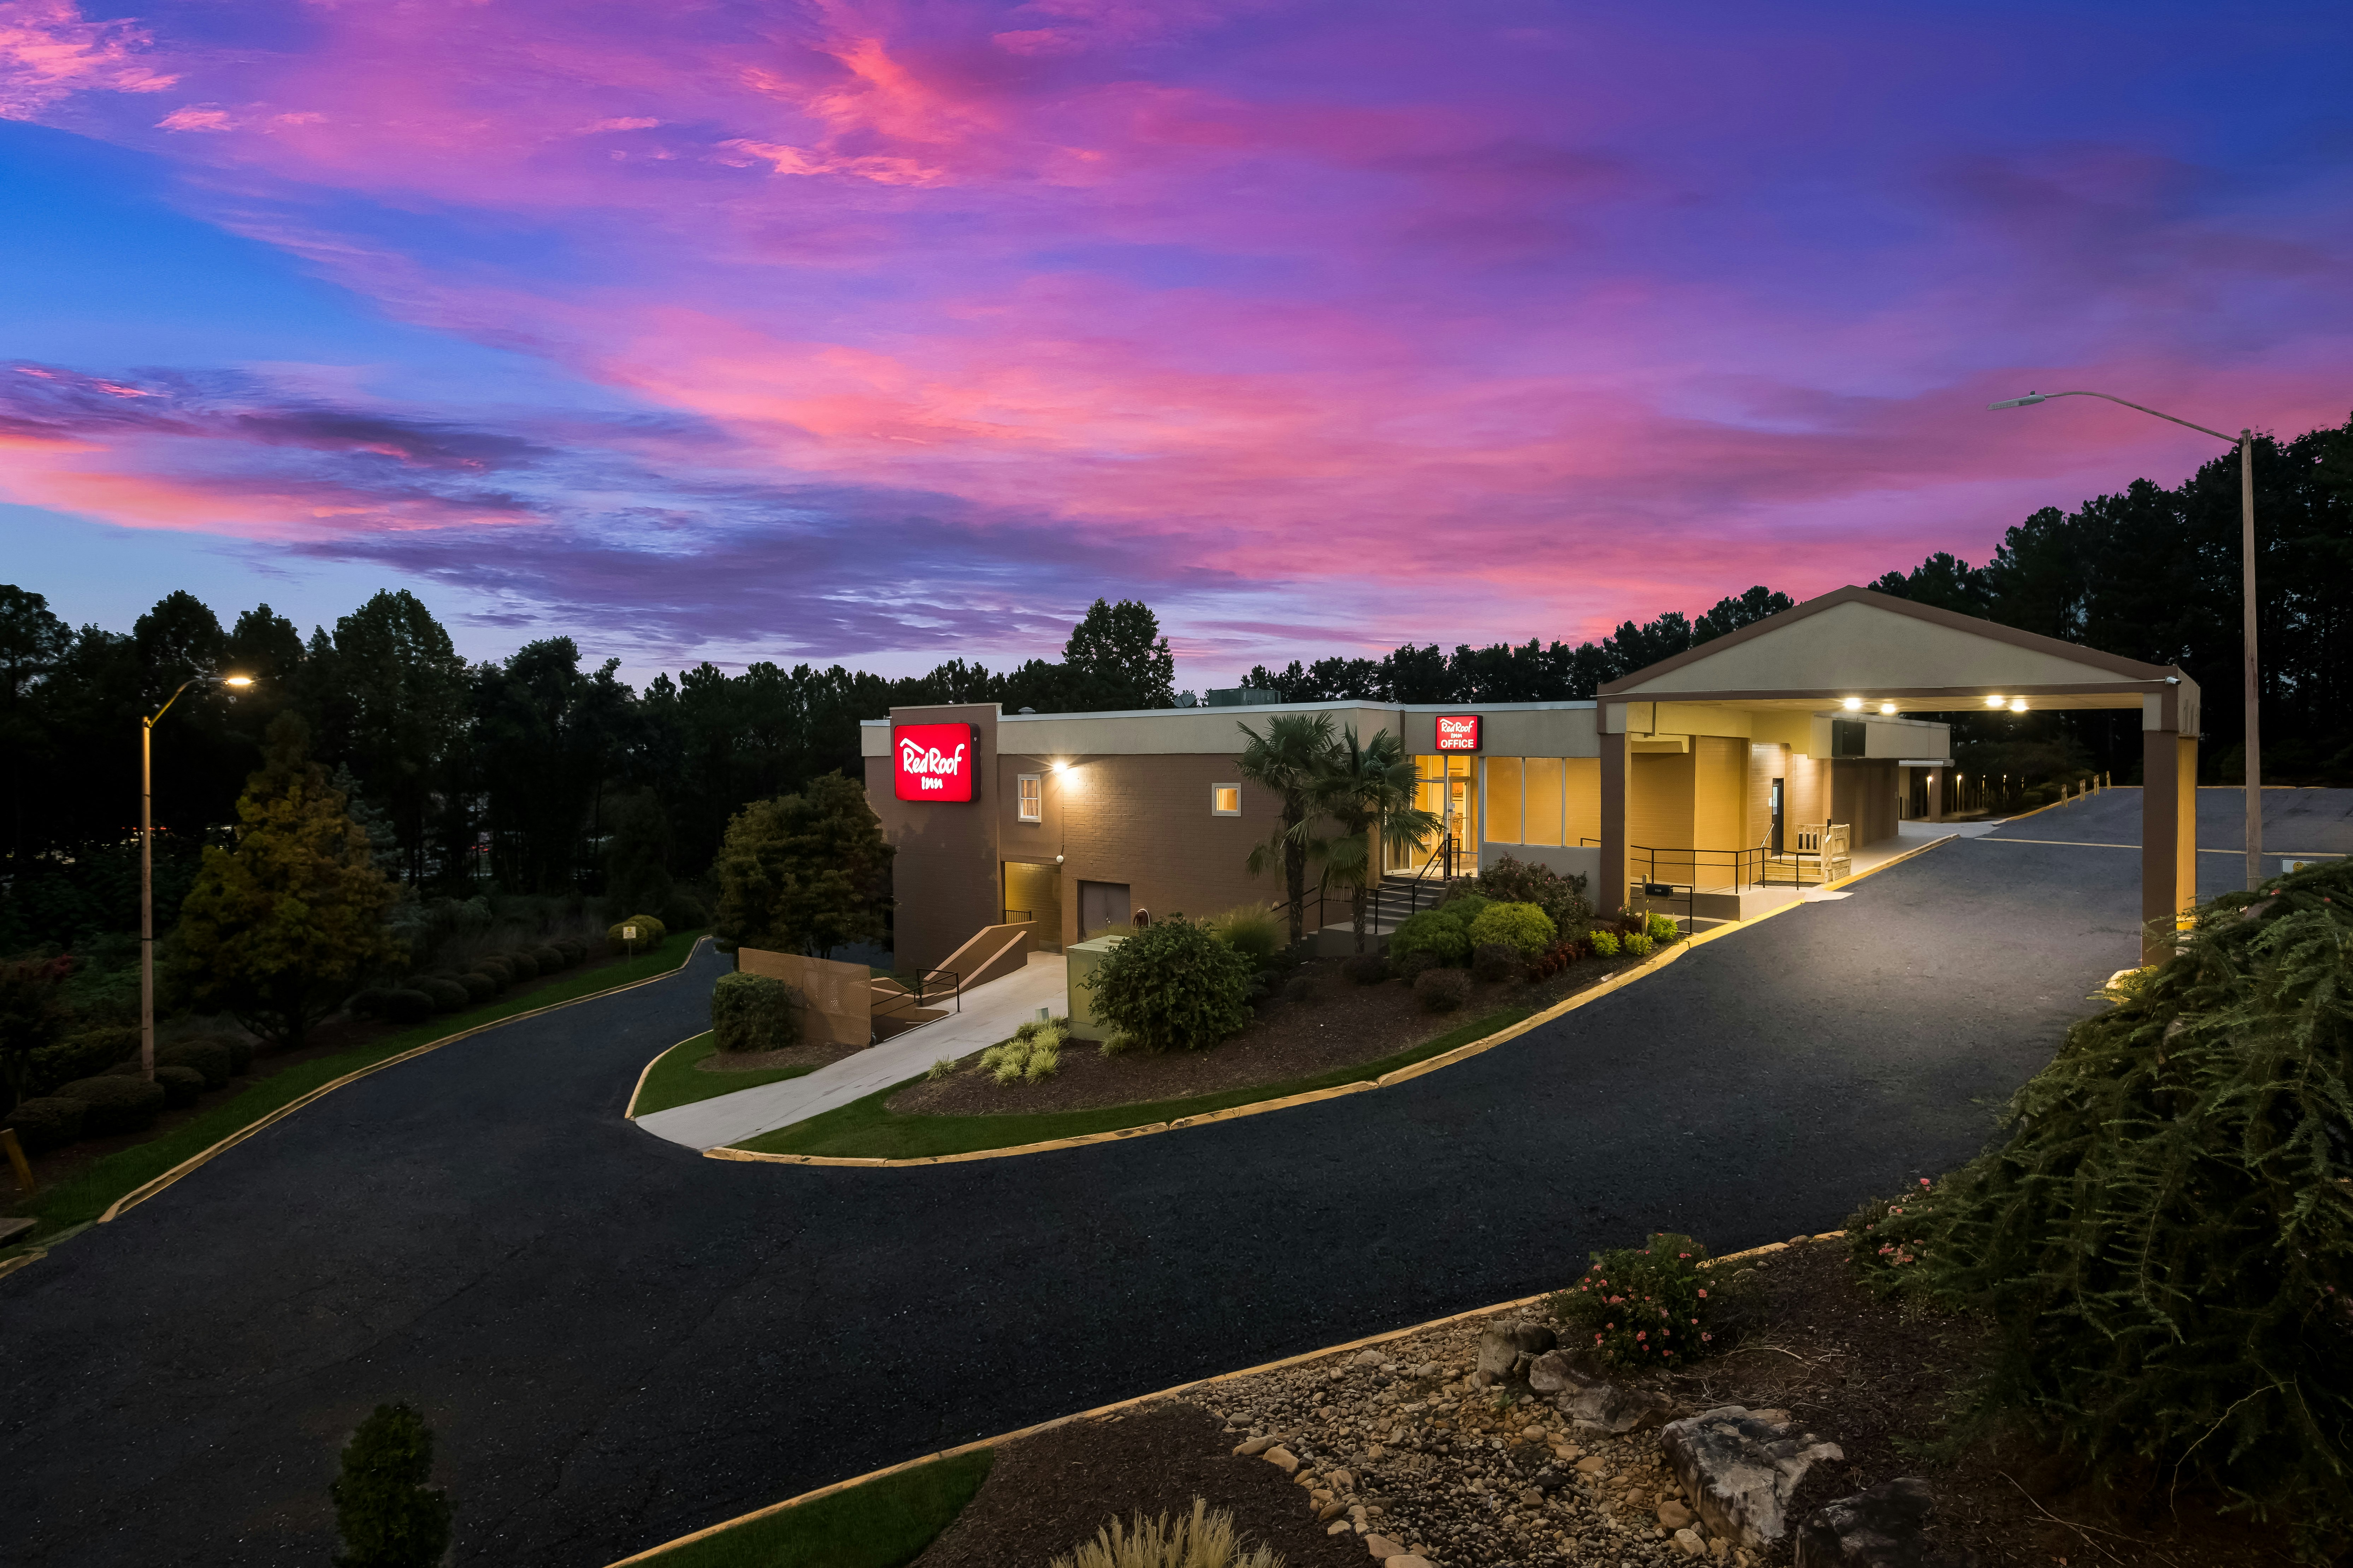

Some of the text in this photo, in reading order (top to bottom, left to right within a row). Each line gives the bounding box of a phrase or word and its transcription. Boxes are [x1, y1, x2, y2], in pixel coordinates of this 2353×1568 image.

[1441, 720, 1474, 733] Red Roof
[1440, 739, 1474, 748] OFFICE
[903, 743, 965, 776] Red Roof
